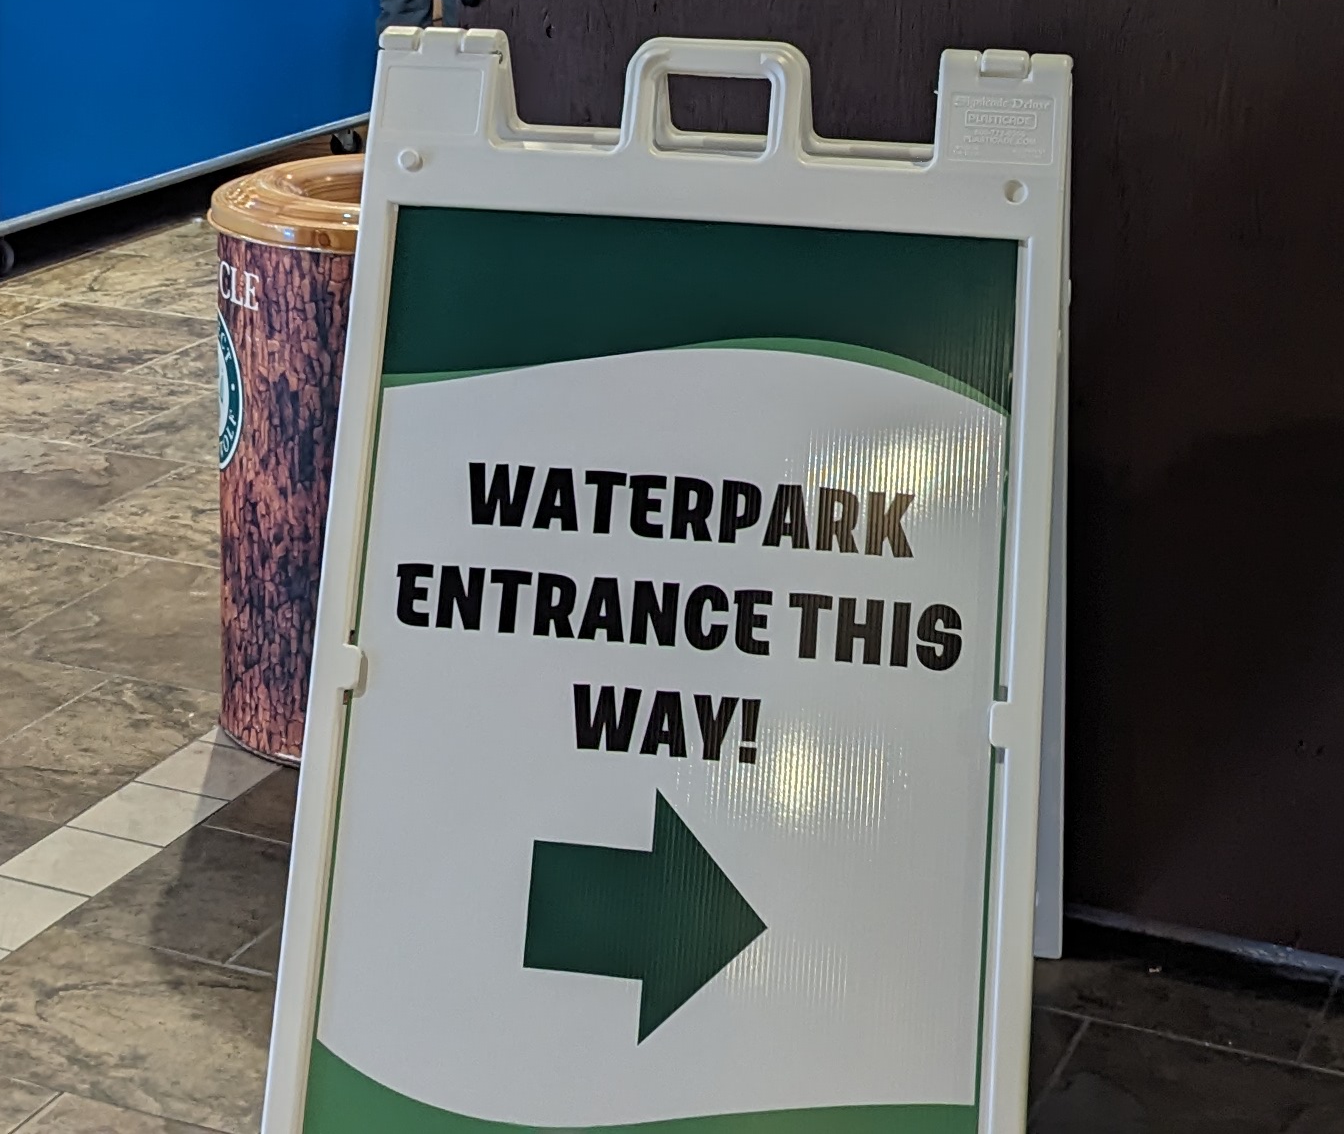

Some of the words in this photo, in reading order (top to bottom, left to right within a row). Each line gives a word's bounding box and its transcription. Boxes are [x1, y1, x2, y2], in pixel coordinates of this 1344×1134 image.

[468, 462, 915, 558] WATERPARK
[395, 563, 773, 656] ENTRANCE
[789, 592, 963, 672] THIS
[572, 684, 762, 765] WAY!
